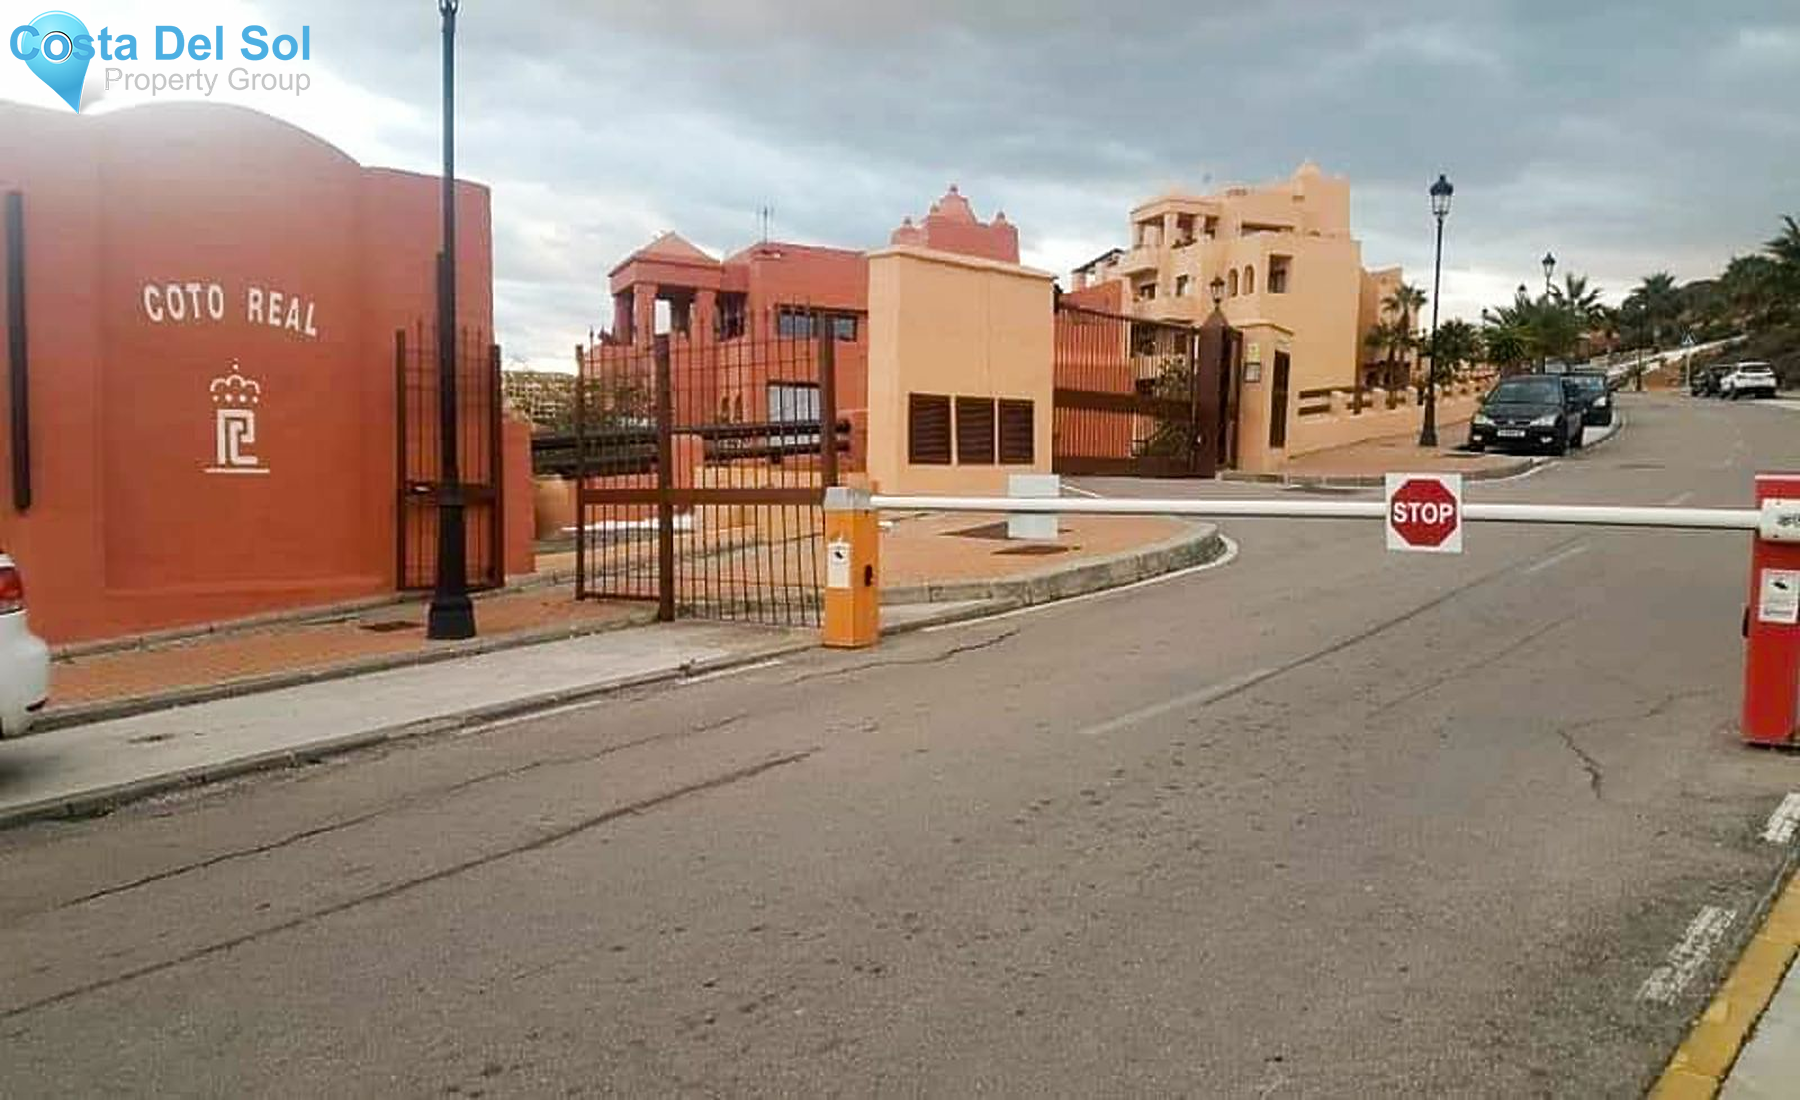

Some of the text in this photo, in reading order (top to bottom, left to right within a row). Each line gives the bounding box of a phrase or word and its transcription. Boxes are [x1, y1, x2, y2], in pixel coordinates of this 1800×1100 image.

[144, 283, 317, 336] COTO REAL
[1394, 502, 1454, 525] STOP
